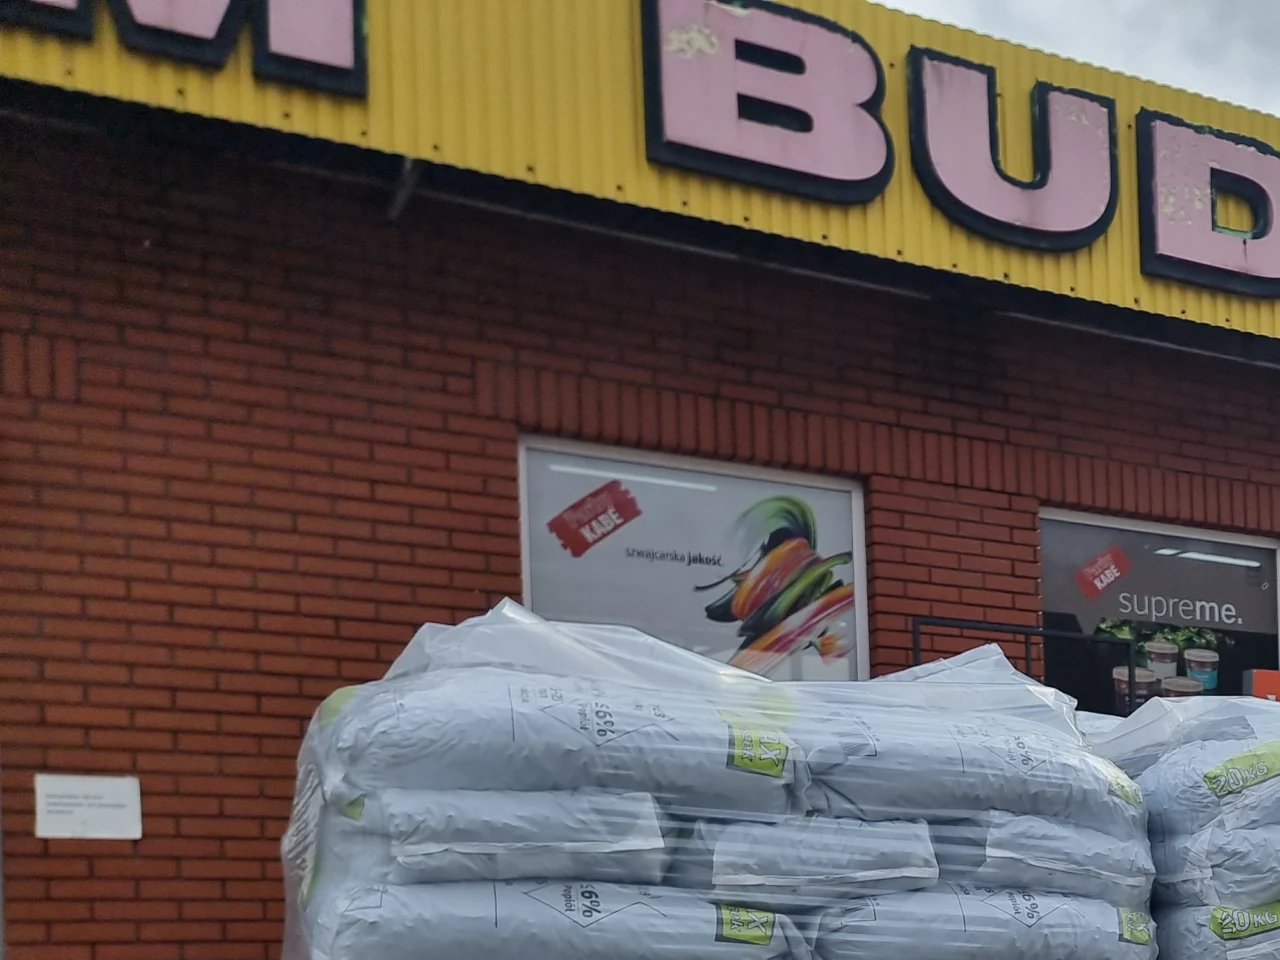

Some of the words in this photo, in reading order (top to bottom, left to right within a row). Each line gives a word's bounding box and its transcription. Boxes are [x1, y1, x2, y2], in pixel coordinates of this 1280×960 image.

[579, 507, 625, 543] KABE
[625, 547, 687, 565] szwajcarska
[1093, 564, 1121, 591] KABE
[1119, 592, 1243, 625] supreme.
